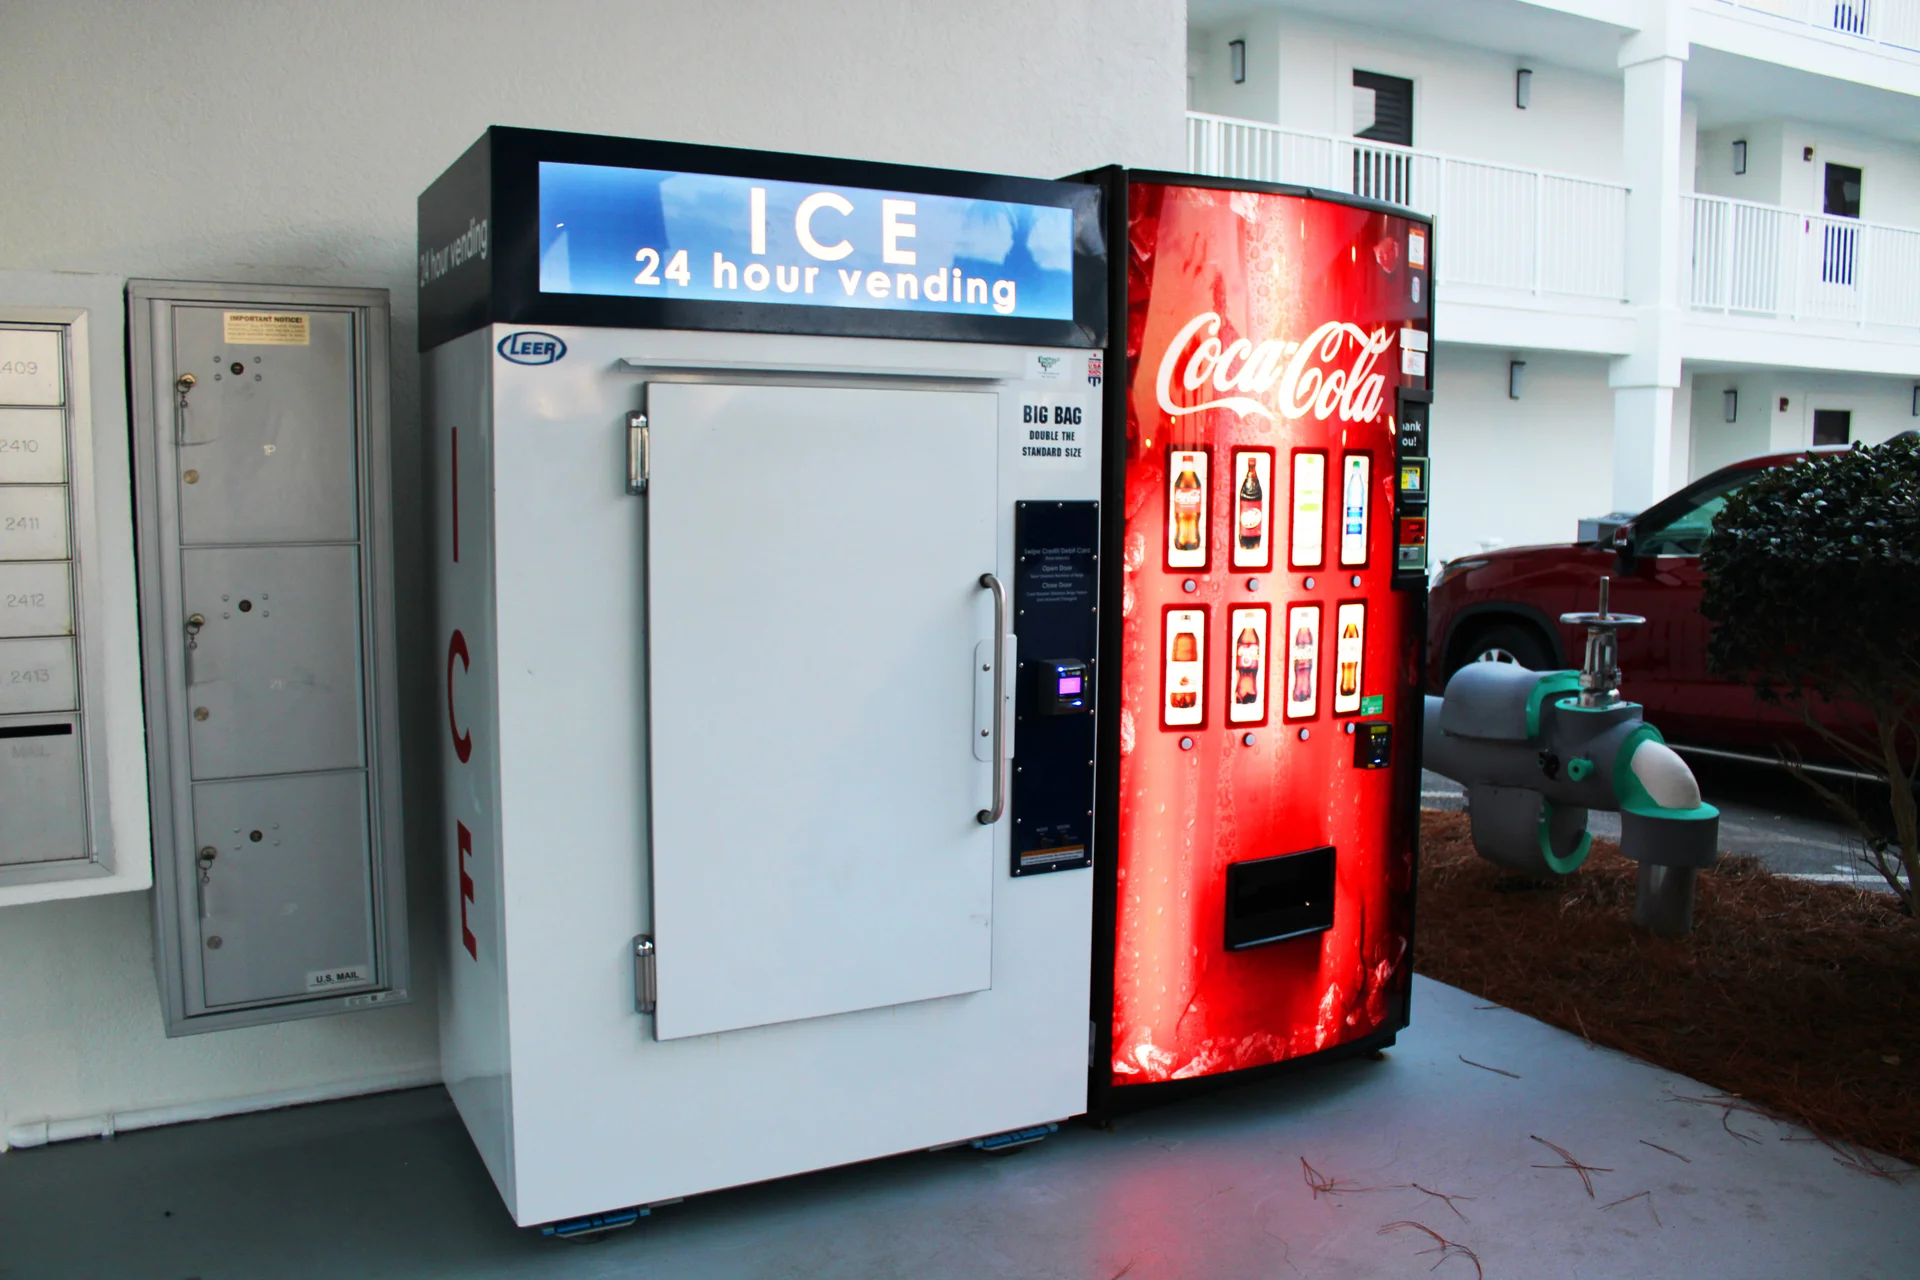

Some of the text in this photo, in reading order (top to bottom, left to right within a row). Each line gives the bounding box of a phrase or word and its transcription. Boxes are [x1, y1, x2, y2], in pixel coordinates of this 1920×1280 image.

[750, 187, 916, 265] ICE
[420, 216, 488, 288] 24 hour vending
[634, 247, 1017, 315] 24 hour vending
[510, 334, 557, 363] LEER
[0, 361, 38, 375] 409
[1156, 312, 1396, 423] Coca-Cola
[1023, 405, 1082, 425] BIG BAG
[1029, 430, 1075, 441] DOUBLE THE
[1402, 436, 1417, 447] ou!
[1022, 446, 1081, 457] STANDARD SIZE
[5, 517, 40, 531] 2411
[6, 593, 45, 607] 2412
[10, 668, 50, 684] 2413
[316, 971, 359, 983] U.S. MAIL
